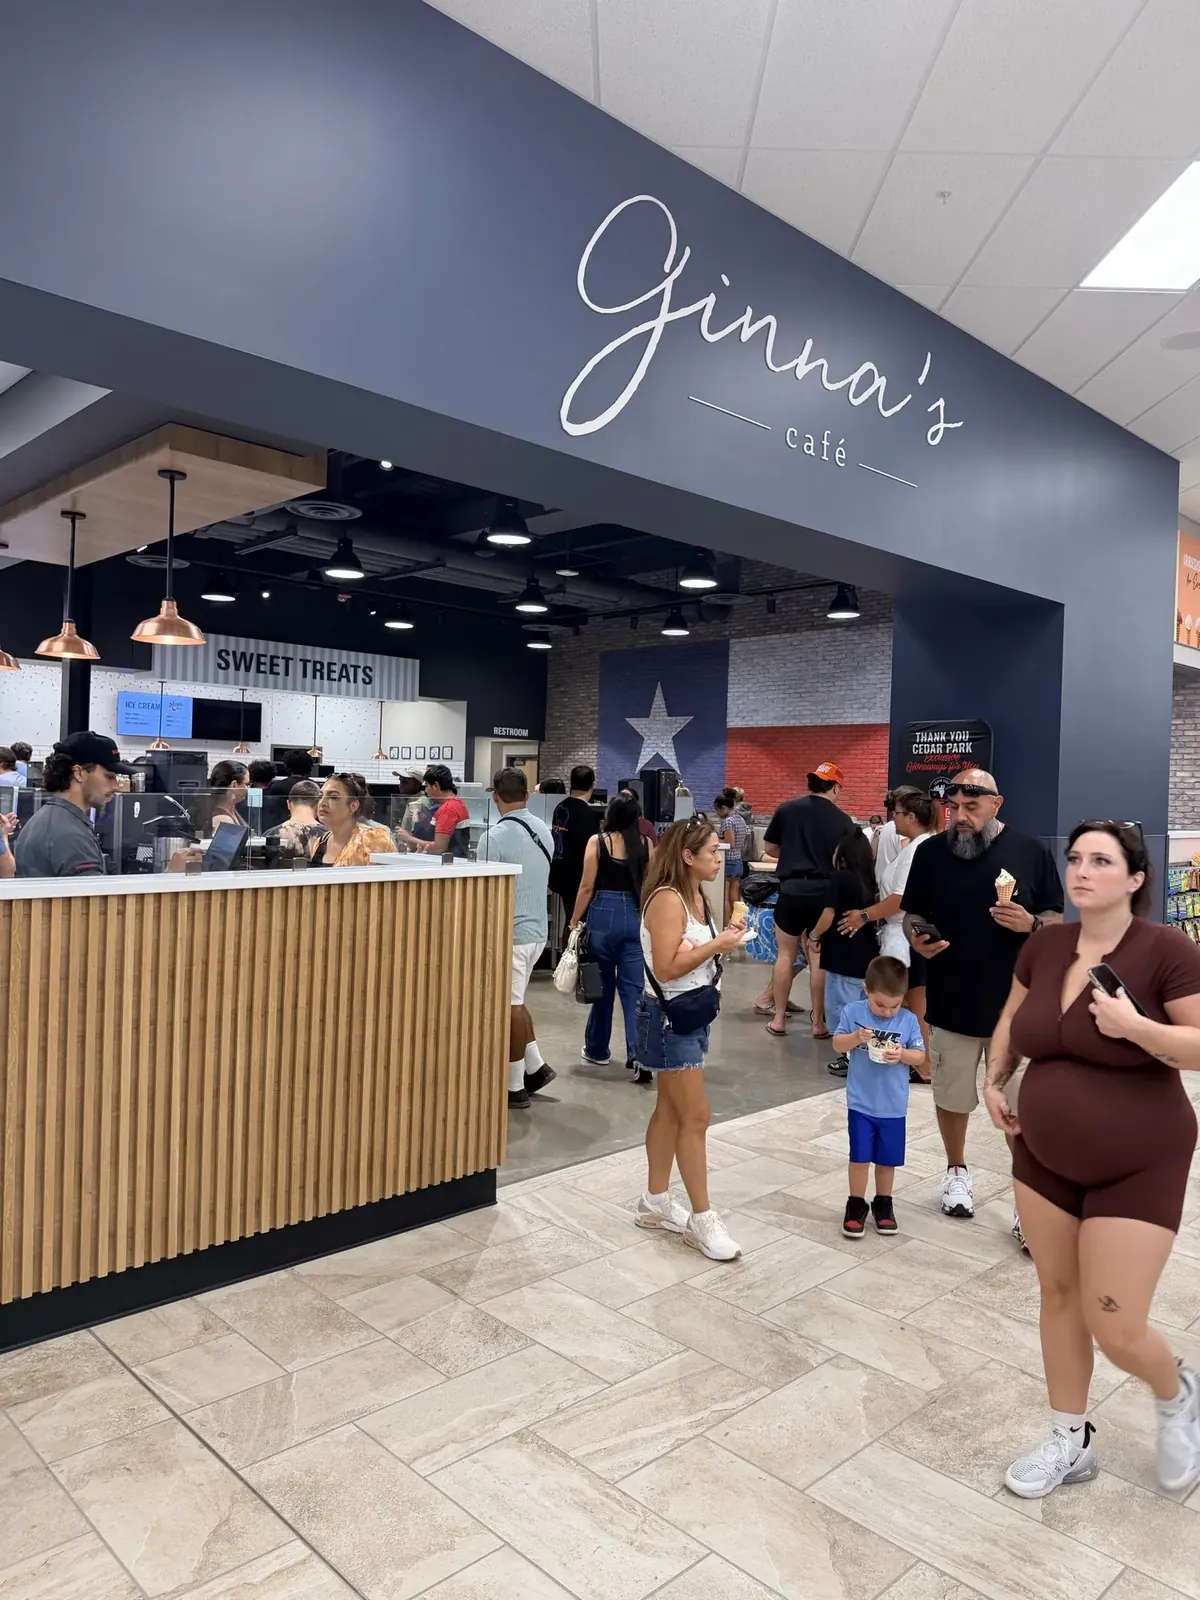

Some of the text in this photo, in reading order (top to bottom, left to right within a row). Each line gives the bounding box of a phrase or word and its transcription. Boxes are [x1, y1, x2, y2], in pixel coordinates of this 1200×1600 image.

[560, 194, 963, 446] Ginna's
[785, 427, 846, 467] café
[216, 649, 373, 685] SWEET TREATS
[125, 700, 137, 709] ICE
[138, 702, 161, 711] CREAM
[493, 726, 529, 737] RESTROOM
[915, 730, 970, 743] THANK YOU
[912, 742, 973, 755] CEDAR PARK
[905, 761, 947, 775] Giveaways
[948, 762, 961, 774] for
